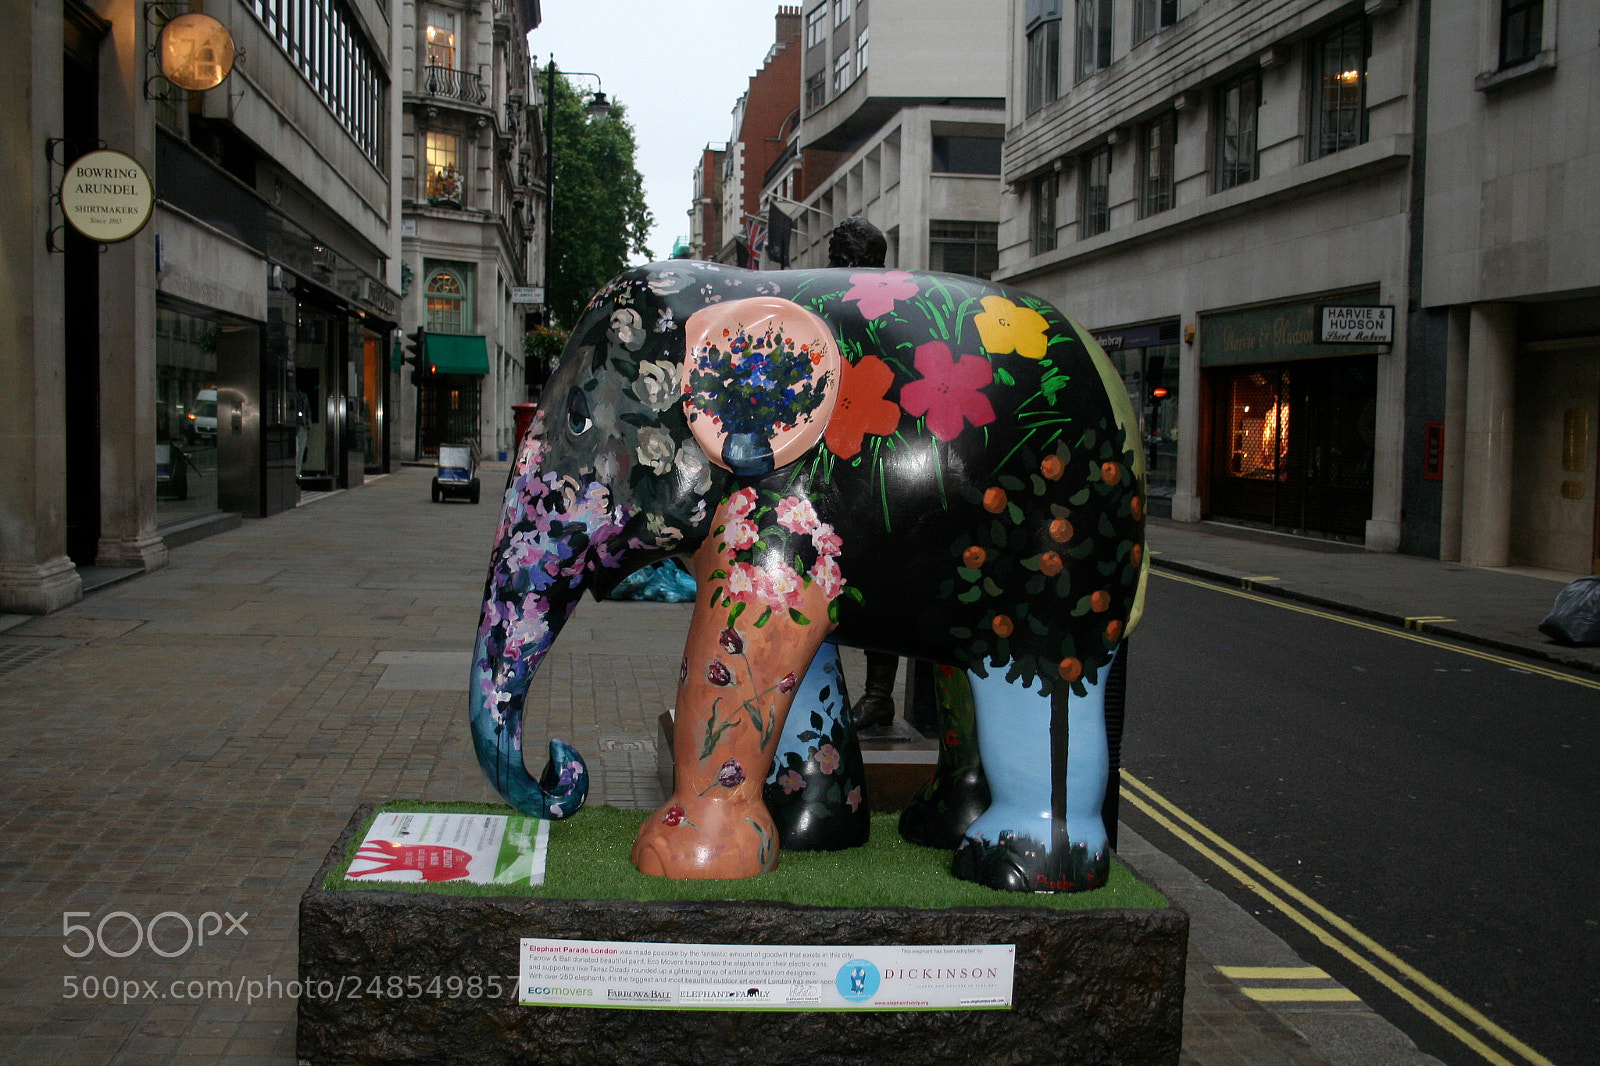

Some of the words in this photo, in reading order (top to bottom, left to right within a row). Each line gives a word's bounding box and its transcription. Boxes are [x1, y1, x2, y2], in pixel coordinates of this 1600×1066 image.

[76, 167, 137, 179] BOWRING
[75, 183, 139, 195] ARUNDEL
[75, 205, 138, 214] SHIRTMAKERS
[1328, 309, 1372, 319] HARVIE
[1379, 310, 1386, 319] &
[1330, 320, 1384, 329] HUDSON
[1325, 331, 1351, 341] Shirt
[1355, 331, 1387, 341] Makers
[529, 945, 561, 953] Elephant
[652, 949, 678, 957] possible
[762, 951, 788, 959] goodwill
[542, 964, 575, 972] supporters
[685, 959, 720, 967] transported
[884, 967, 998, 979] DICKINSON
